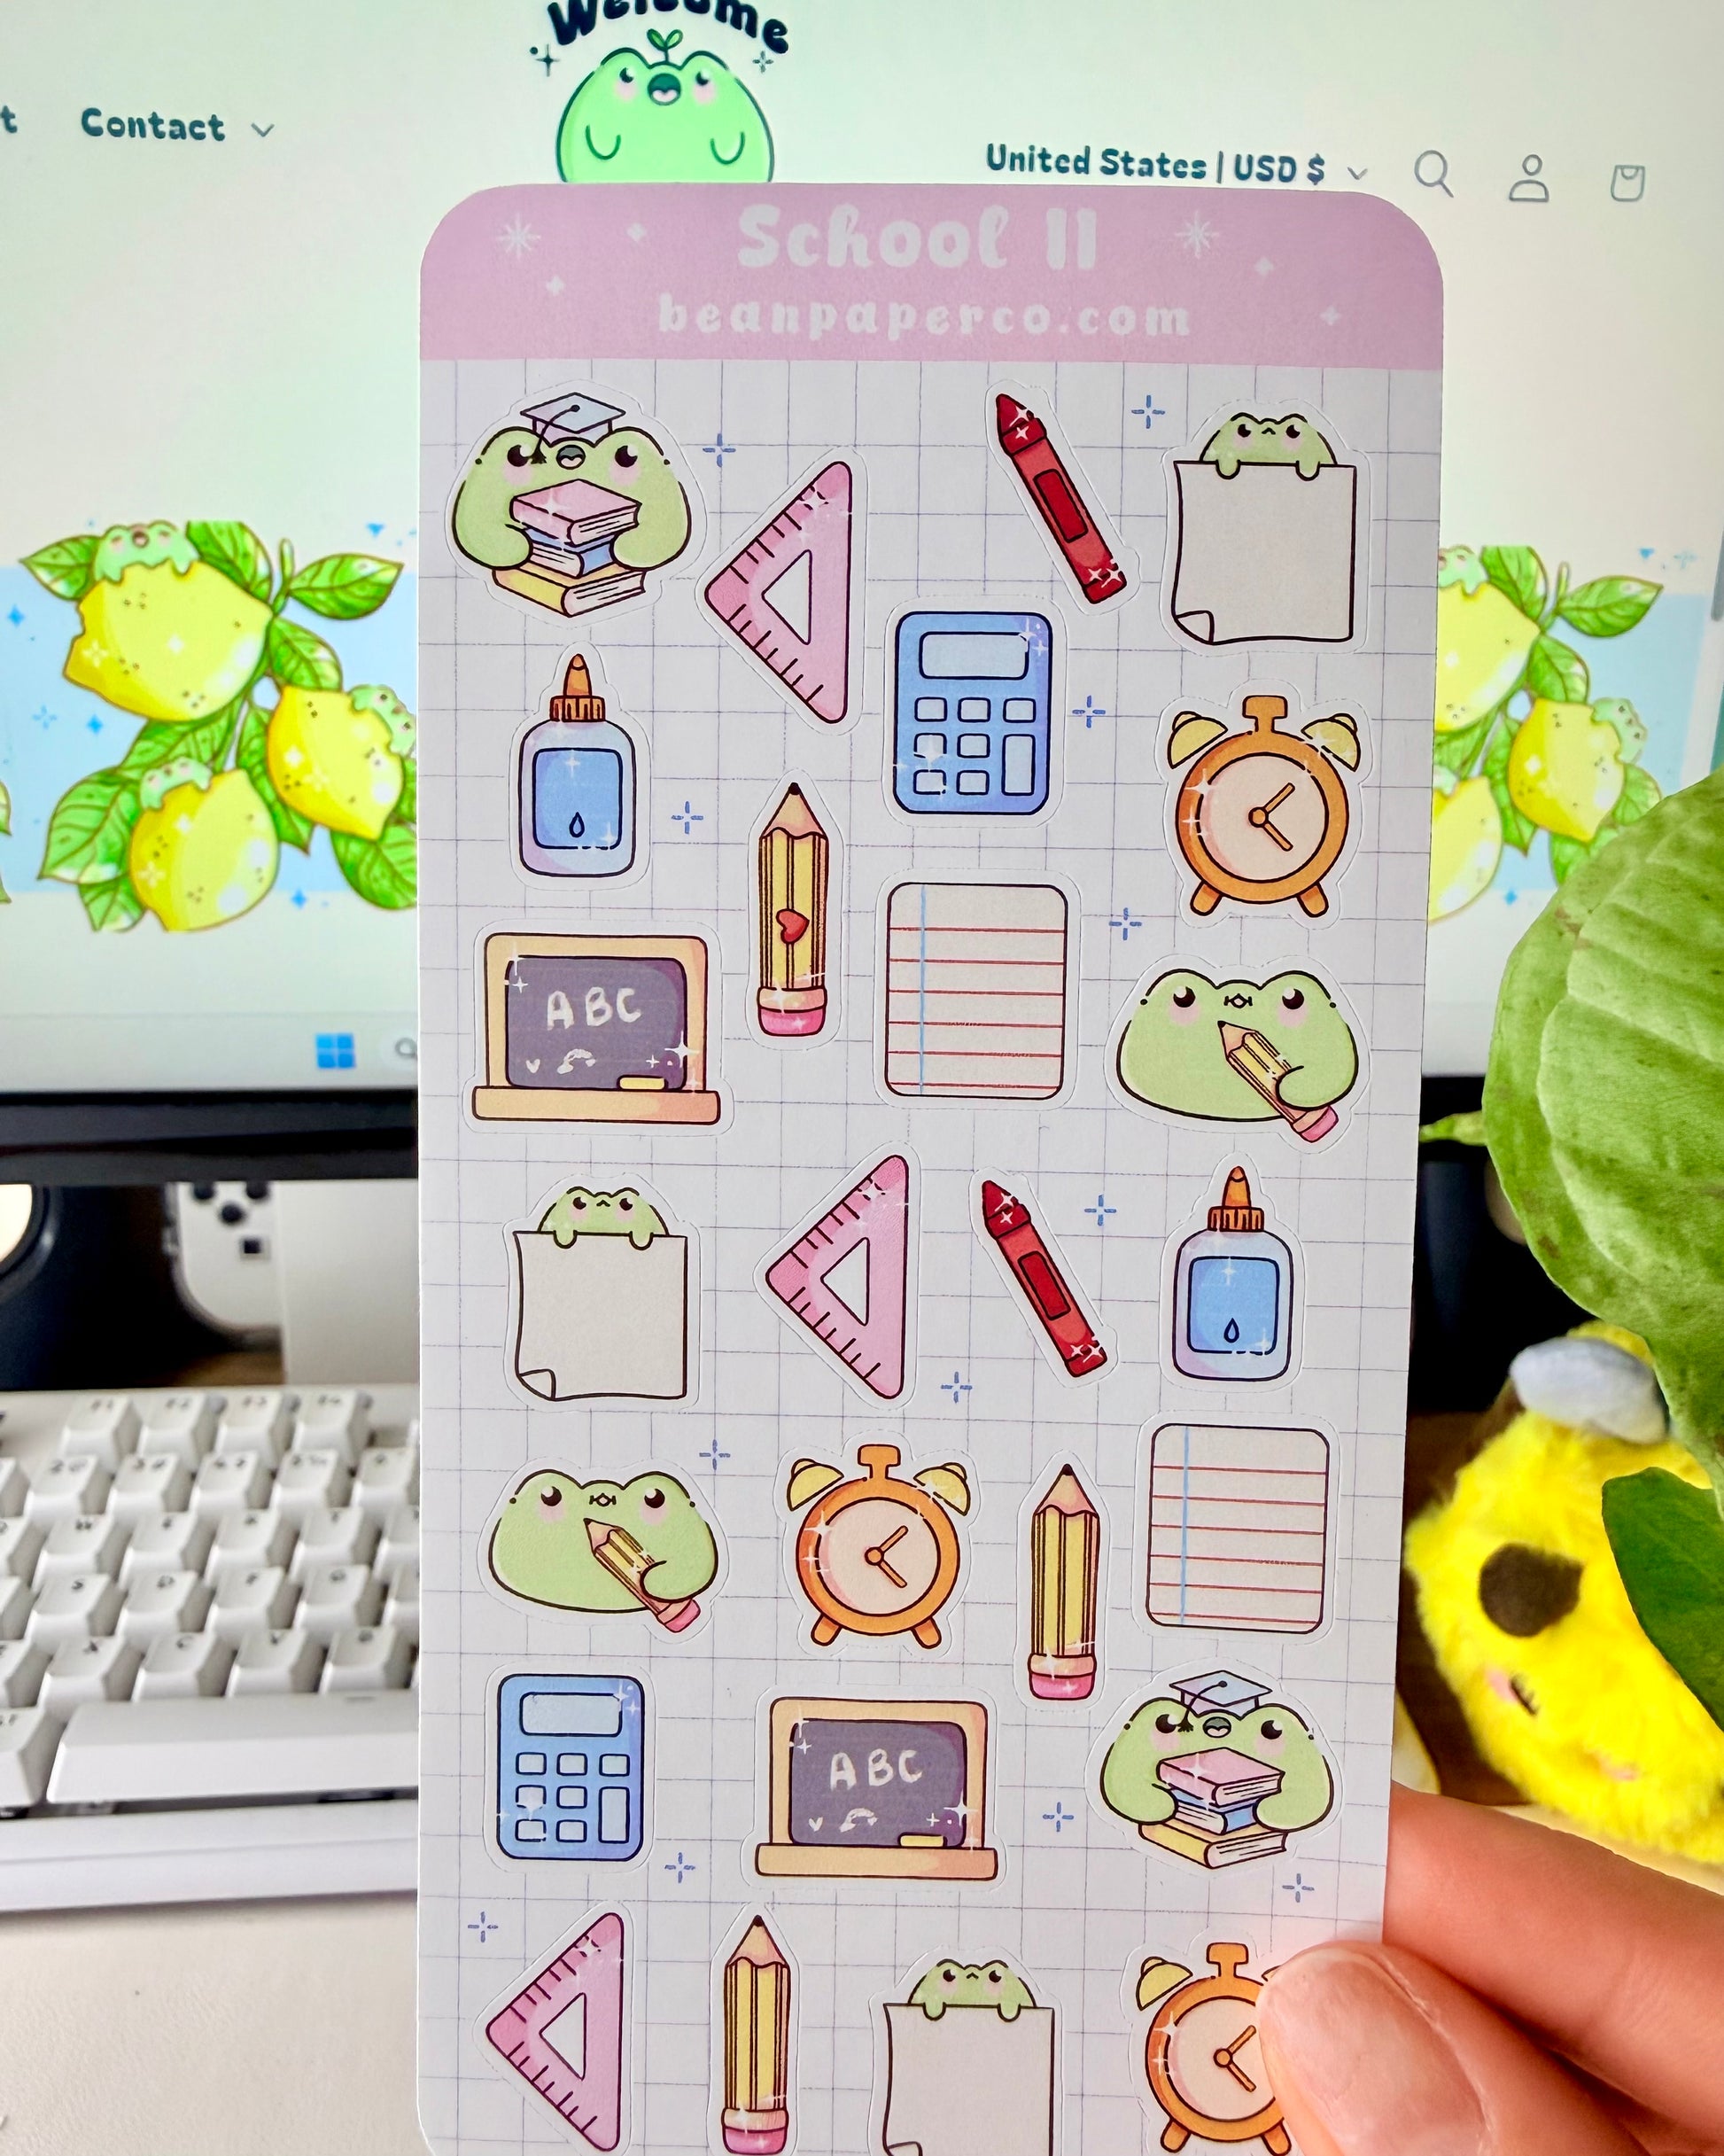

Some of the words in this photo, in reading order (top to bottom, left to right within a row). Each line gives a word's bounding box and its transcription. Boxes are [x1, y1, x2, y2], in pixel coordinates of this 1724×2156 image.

[81, 106, 226, 142] Contact
[987, 143, 1091, 175] United
[1099, 148, 1208, 180] States
[1235, 154, 1299, 183] USD
[1307, 153, 1327, 186] $
[738, 203, 1012, 269] School
[658, 292, 1191, 341] beanpaperco.com
[547, 985, 643, 1032] ABC
[829, 1747, 924, 1792] ABC
